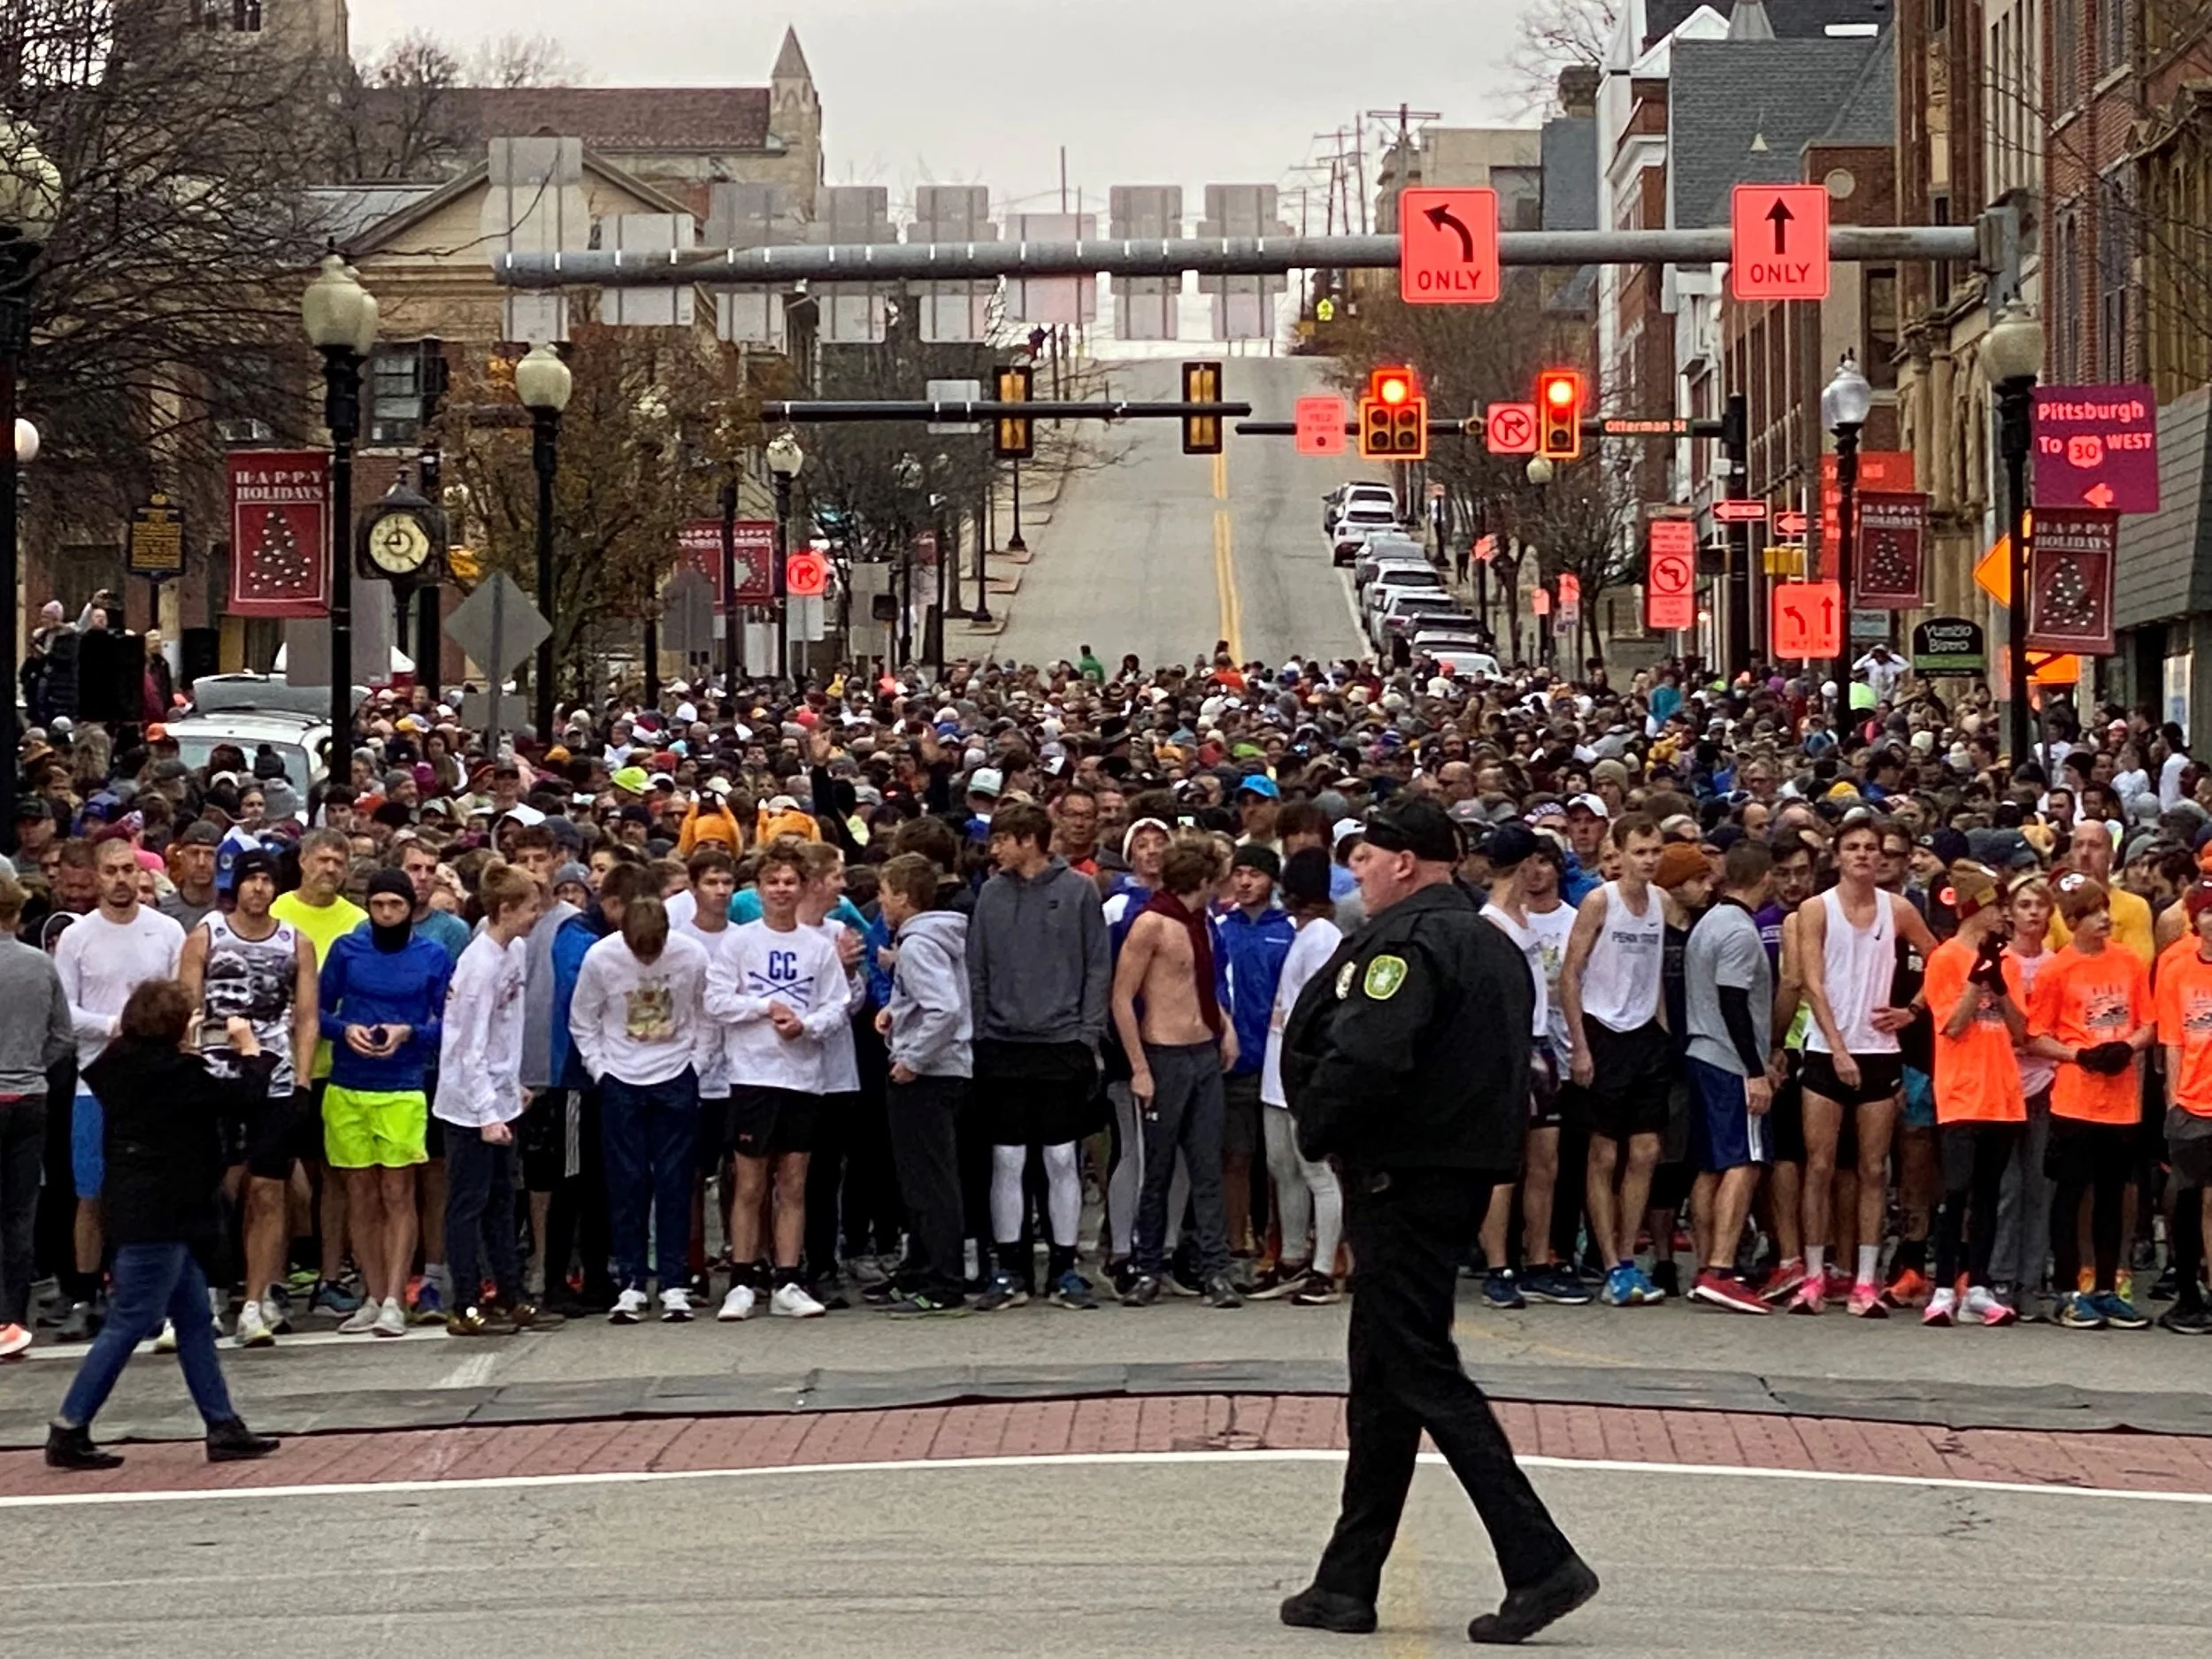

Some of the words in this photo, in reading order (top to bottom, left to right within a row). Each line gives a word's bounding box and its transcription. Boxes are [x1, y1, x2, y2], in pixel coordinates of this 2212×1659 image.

[1417, 270, 1482, 291] ONLY
[1750, 263, 1811, 283] ONLY
[2038, 400, 2145, 423] Pittsburgh
[1605, 420, 1671, 433] Otterman
[1672, 419, 1687, 432] St
[2039, 436, 2062, 454] To
[2073, 443, 2098, 460] 30
[2106, 433, 2153, 449] WEST
[236, 487, 324, 500] HOLIDAYS
[2035, 536, 2112, 548] HOLIDAYS
[768, 949, 797, 980] CC
